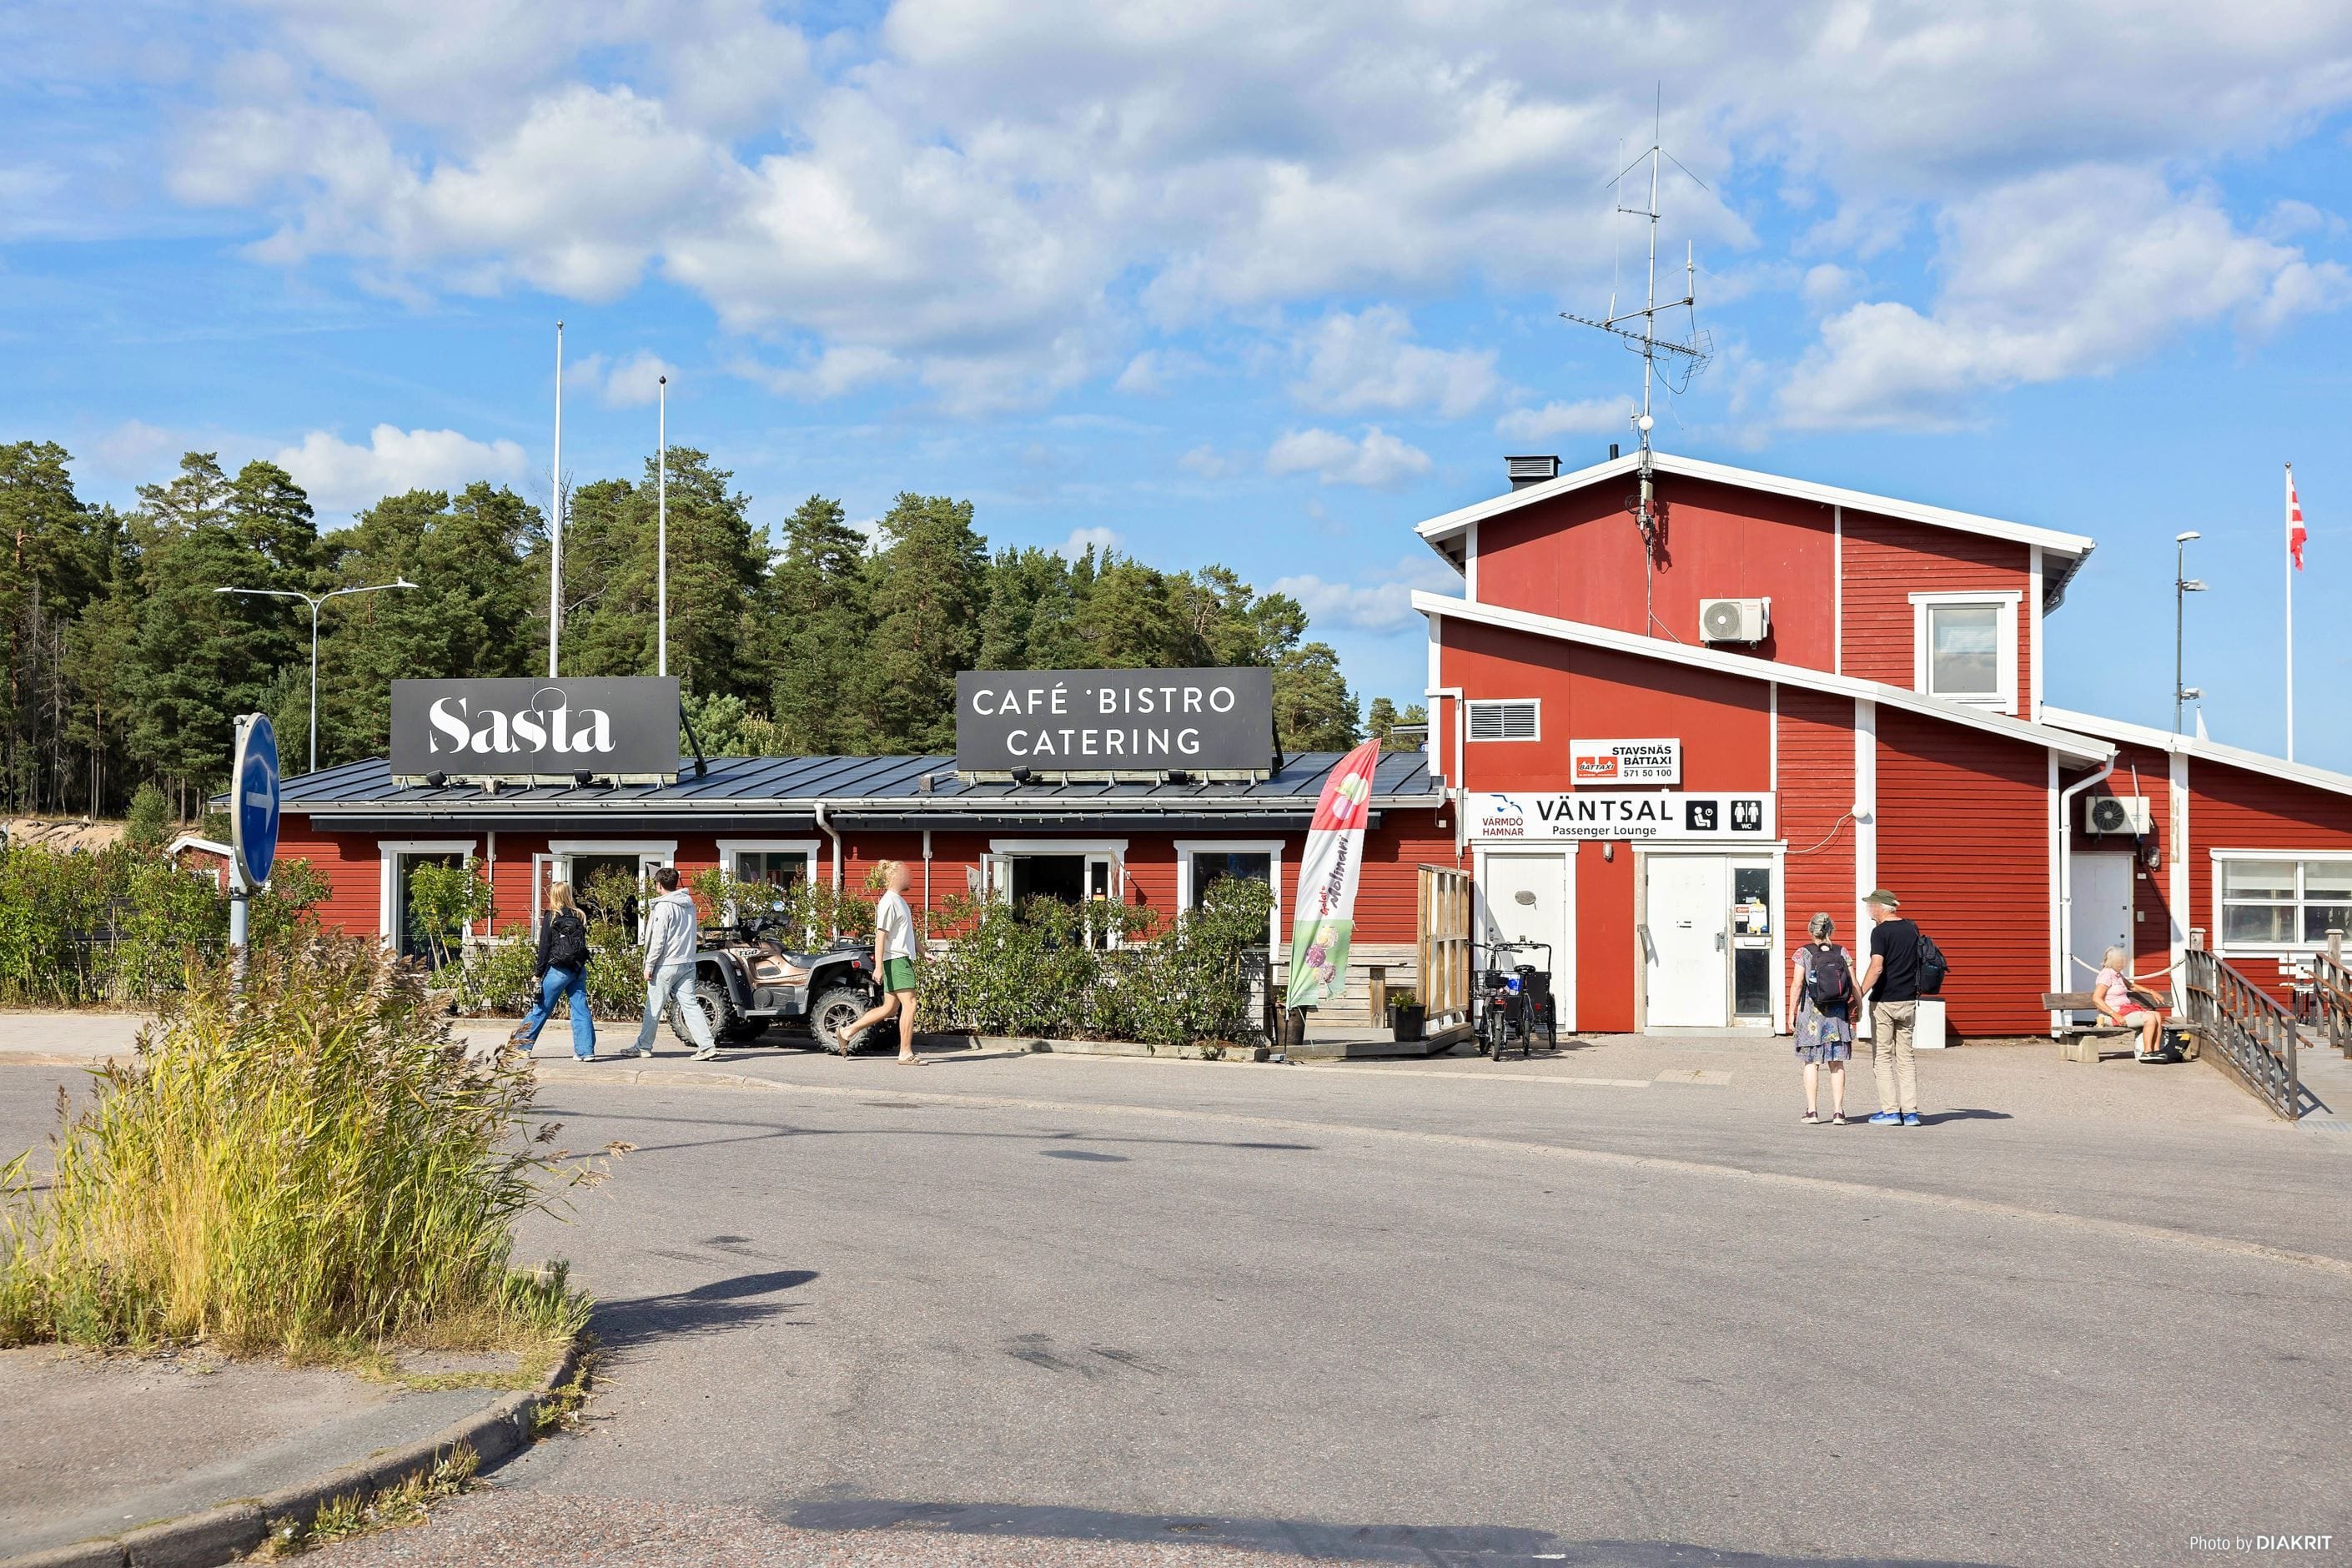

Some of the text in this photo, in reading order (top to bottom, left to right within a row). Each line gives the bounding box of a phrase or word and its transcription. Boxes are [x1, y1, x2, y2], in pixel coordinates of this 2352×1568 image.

[972, 681, 1068, 716] CAFÉ
[430, 687, 616, 754] Sasta
[1007, 728, 1200, 756] CATERING
[1612, 744, 1671, 756] STAVSNÄS
[1624, 755, 1671, 765] BÅTTAXI
[1536, 795, 1674, 821] VÄNTSAL
[1482, 817, 1524, 826] VÄRMDÖ
[1482, 827, 1524, 836] HAMNAR
[1552, 826, 1656, 837] Passenger Lounge
[1328, 835, 1349, 909] Molinari
